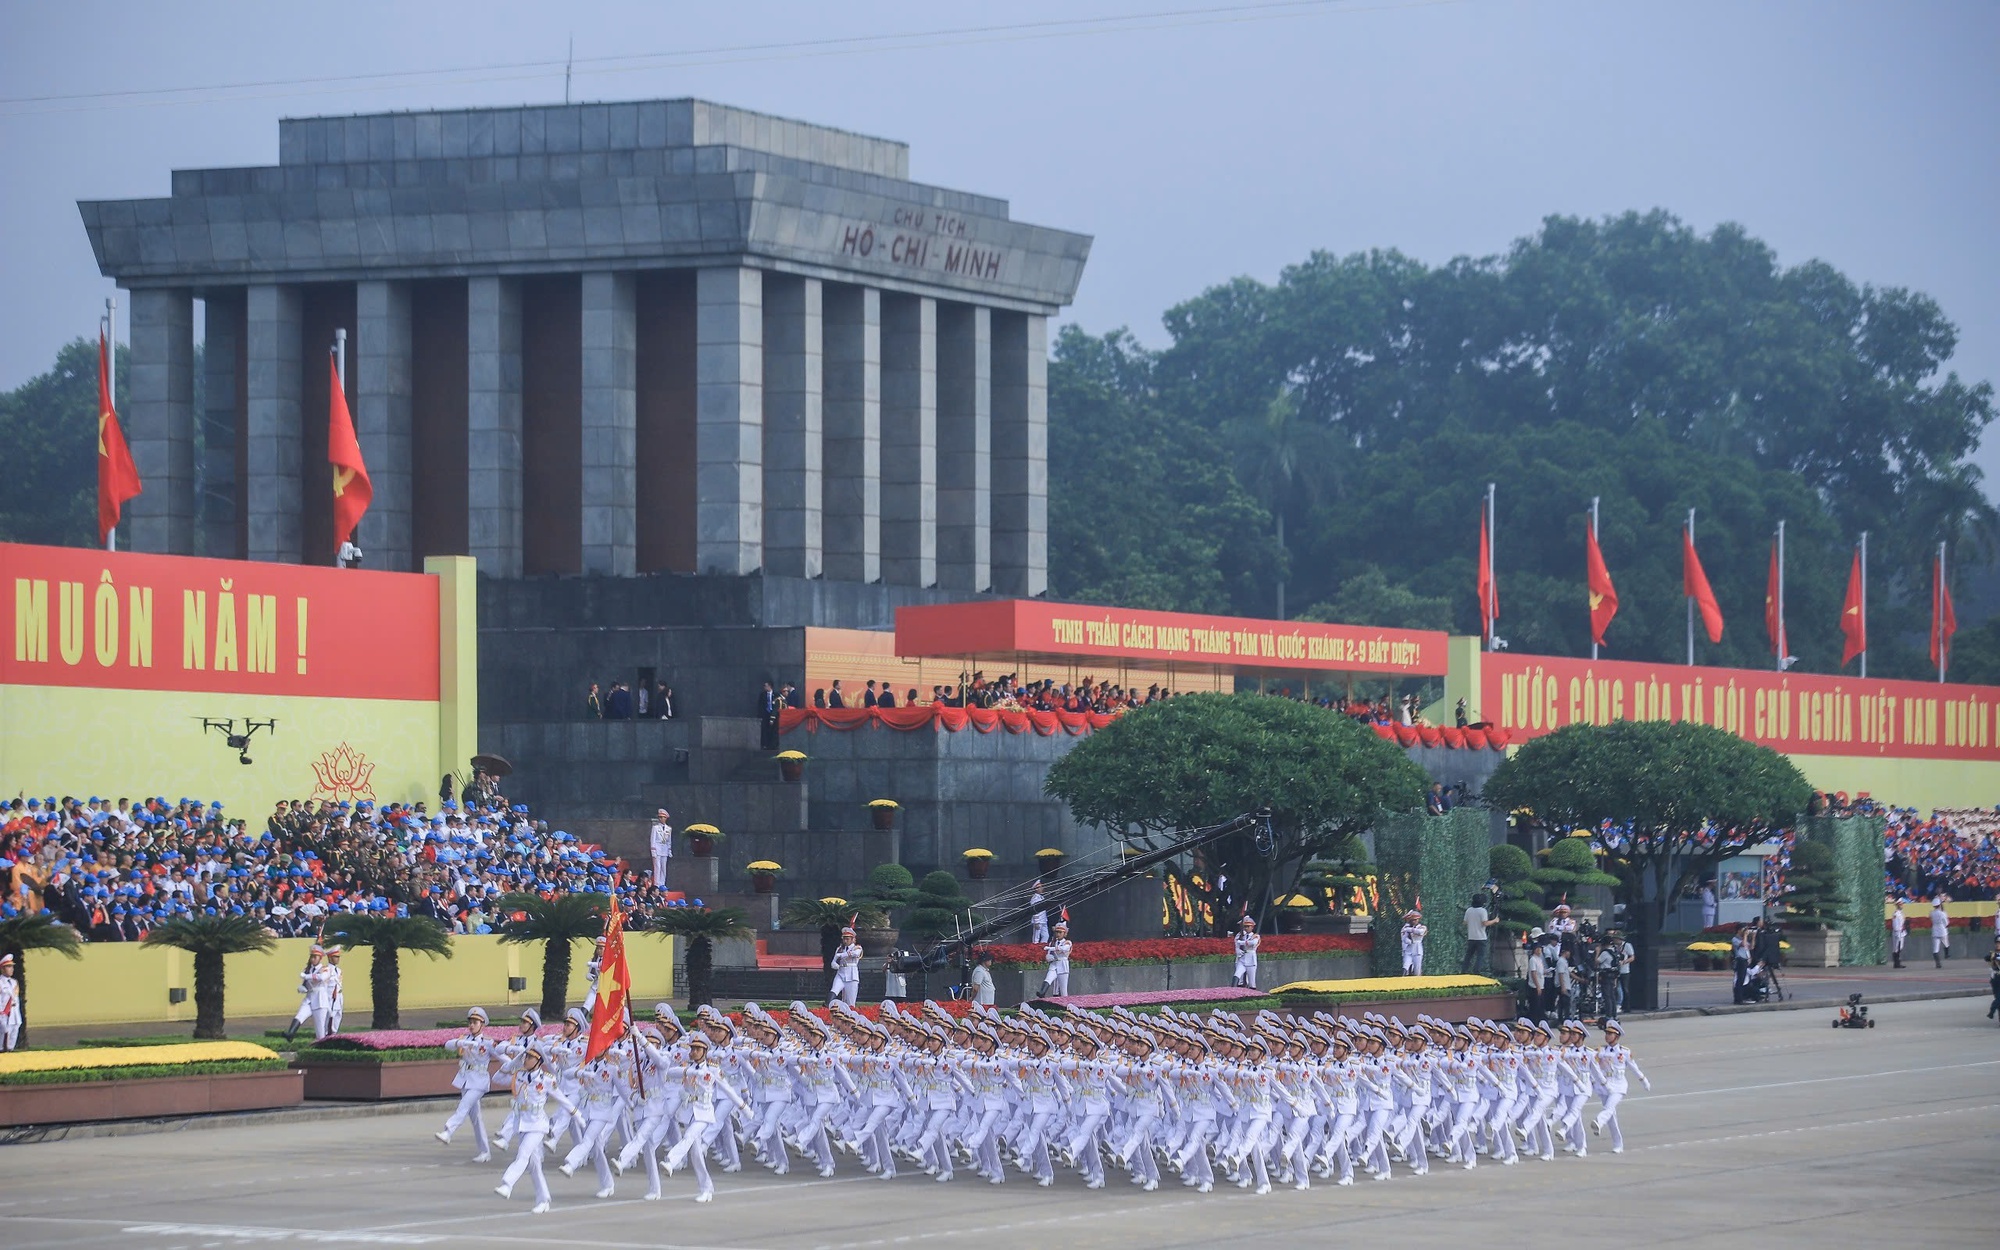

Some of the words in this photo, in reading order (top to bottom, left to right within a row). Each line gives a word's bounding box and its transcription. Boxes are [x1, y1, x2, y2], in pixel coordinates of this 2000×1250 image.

[15, 568, 153, 668] MUÔN
[183, 577, 277, 674] NĂM
[1052, 618, 1084, 645] TINH
[1086, 614, 1120, 647] THẦN
[1122, 619, 1154, 649] CÁCH
[1156, 626, 1190, 655] MẠNG
[1191, 625, 1231, 655] THÁNG
[1233, 627, 1259, 656] TÁM
[1260, 629, 1276, 657] VÀ
[1277, 628, 1306, 660] QUỐC
[1307, 632, 1345, 661] KHÁNH
[1346, 638, 1367, 663] 2-9
[1368, 634, 1390, 664] BẤT
[1501, 664, 1559, 731] NƯỚC
[1633, 673, 1672, 724] HÒA
[1681, 676, 1705, 727] XÃ
[1754, 677, 1791, 740] CHỦ
[1798, 685, 1853, 742] NGHĨA
[1859, 686, 1898, 753] VIỆT
[1903, 697, 1938, 746] NAM
[1944, 693, 1989, 748] MUÔN
